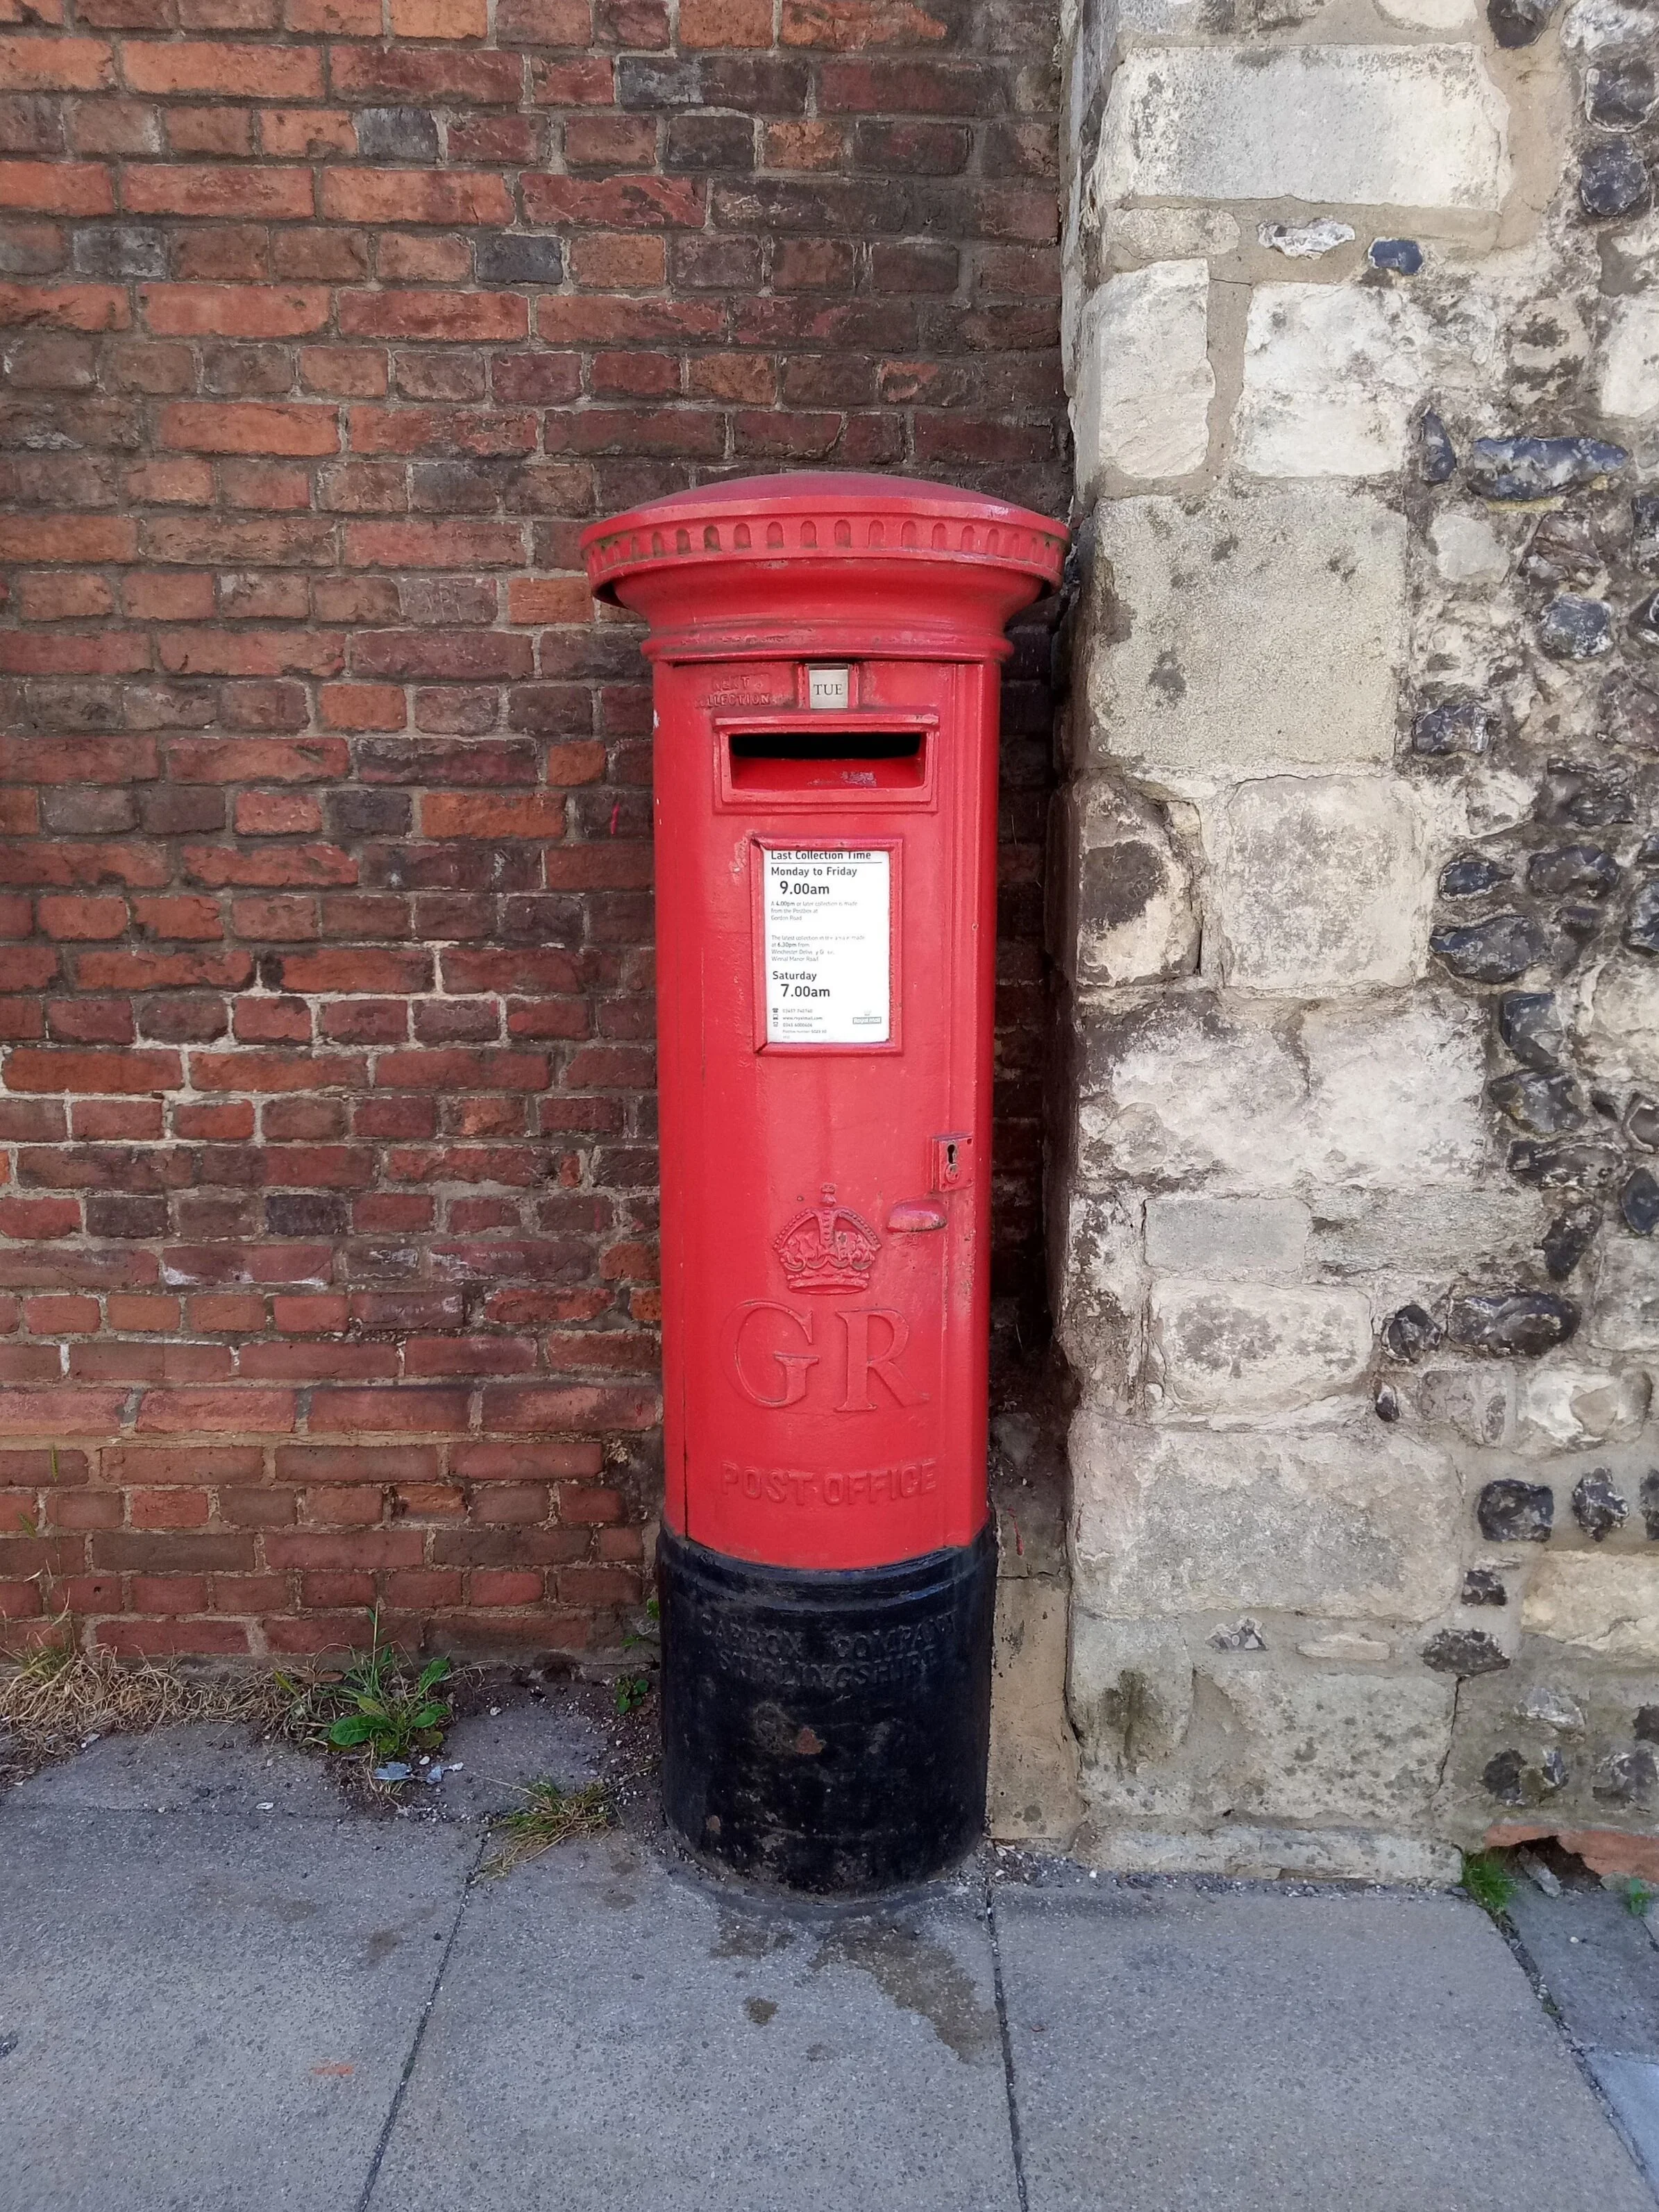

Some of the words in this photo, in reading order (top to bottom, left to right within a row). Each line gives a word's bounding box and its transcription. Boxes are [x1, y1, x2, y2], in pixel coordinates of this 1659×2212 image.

[813, 683, 843, 696] TUE
[770, 851, 792, 860] Last
[795, 851, 843, 860] Collection
[848, 851, 872, 860] Time
[771, 866, 809, 878] Monday
[813, 867, 823, 875] to
[827, 866, 857, 878] Friday
[780, 880, 830, 895] 9.00am
[773, 971, 817, 982] Saturday
[780, 983, 830, 998] 7.00am
[720, 1299, 930, 1412] GR
[721, 1460, 816, 1506] POST
[823, 1458, 937, 1506] OFFICE
